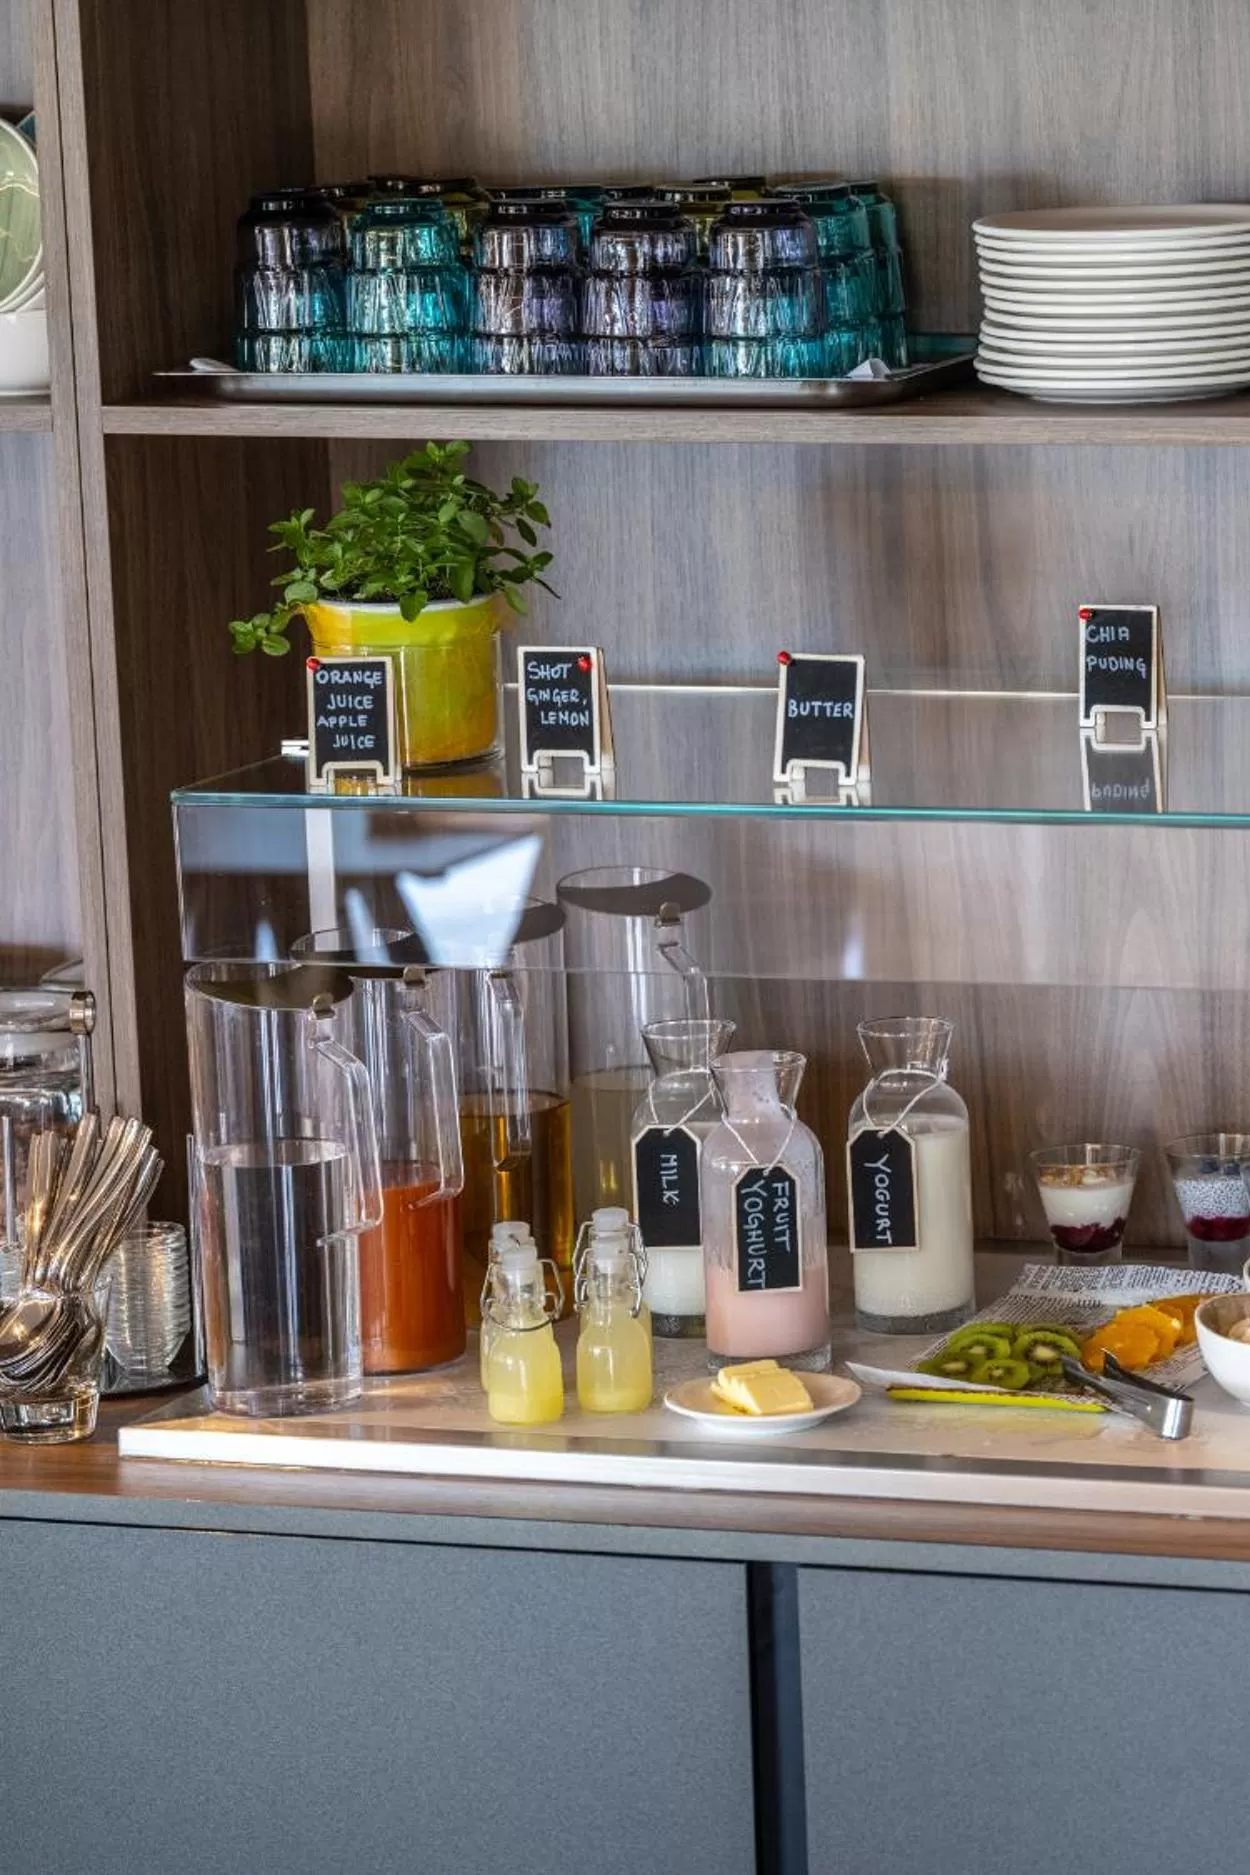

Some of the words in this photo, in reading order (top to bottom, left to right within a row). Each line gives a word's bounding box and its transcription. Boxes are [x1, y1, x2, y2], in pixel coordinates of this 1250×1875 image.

[1085, 625, 1130, 643] CHIA
[527, 660, 573, 680] SHOT
[1086, 655, 1147, 679] PUDING
[316, 669, 383, 689] ORANGE
[327, 693, 375, 710] JUICE
[788, 700, 854, 718] BUTTER
[316, 714, 368, 729] APPLE
[540, 710, 590, 727] LEMON
[332, 734, 377, 750] JUICE
[659, 1153, 681, 1207] MILK
[863, 1153, 892, 1245] YOGURT
[771, 1181, 791, 1253] FRUIT
[740, 1180, 767, 1290] YOGHURT
